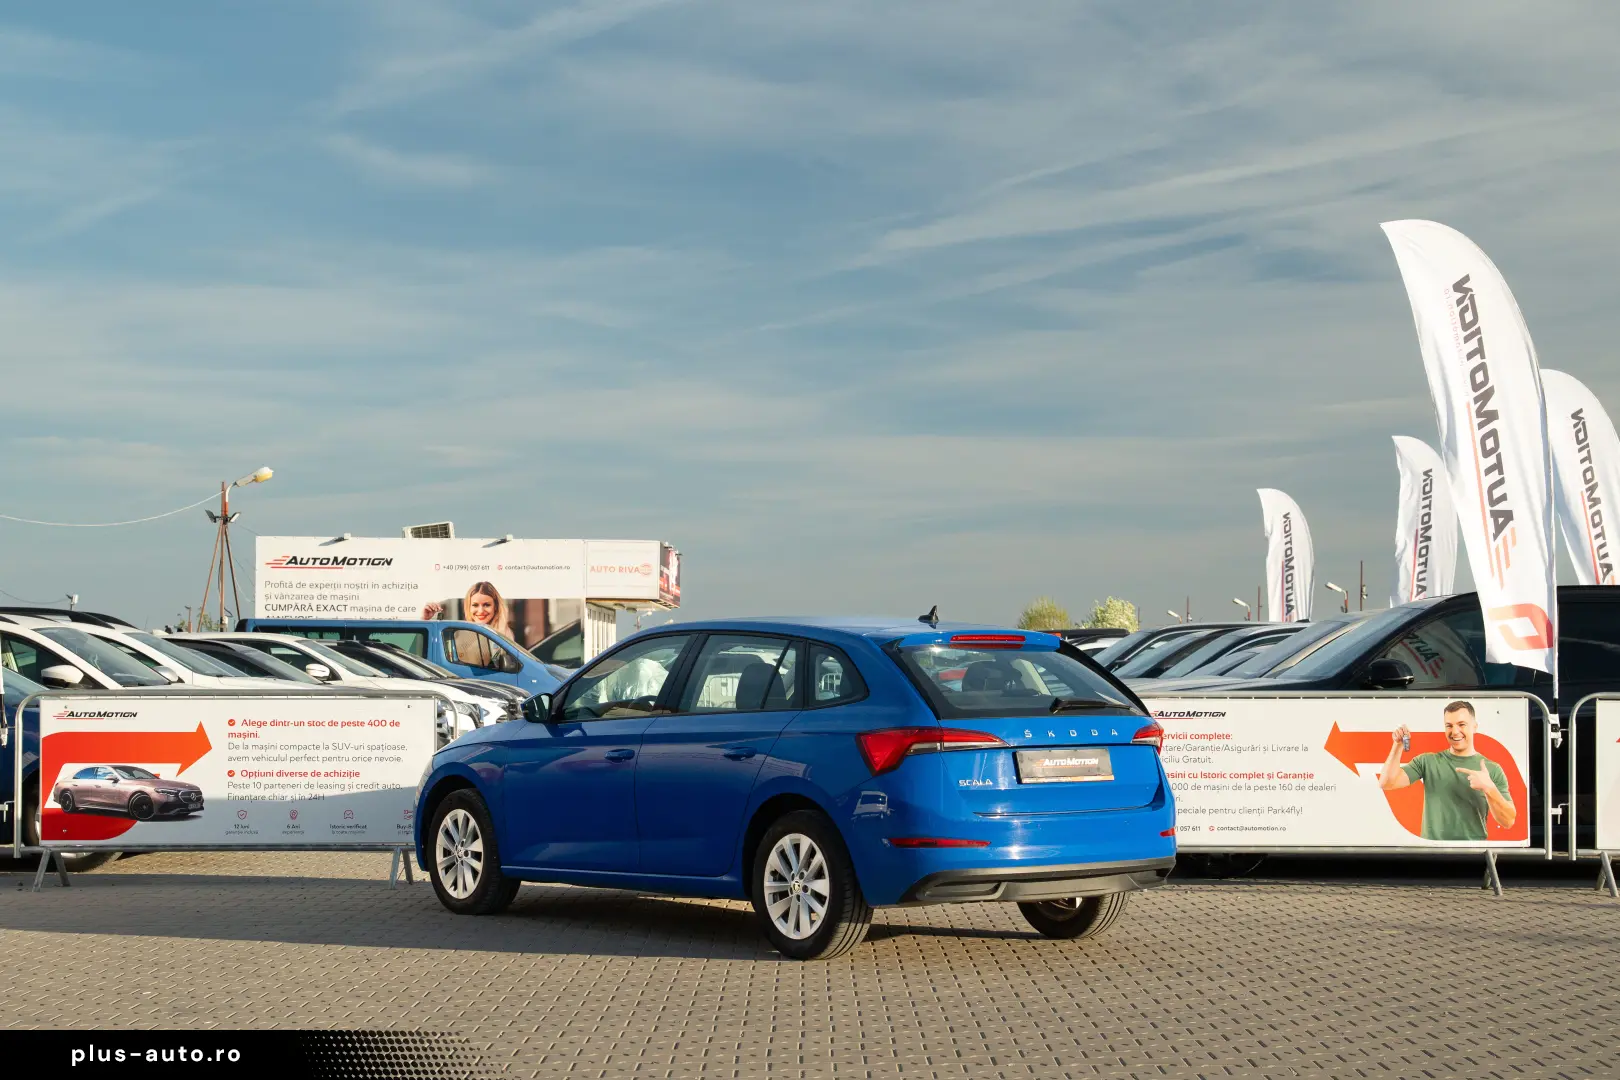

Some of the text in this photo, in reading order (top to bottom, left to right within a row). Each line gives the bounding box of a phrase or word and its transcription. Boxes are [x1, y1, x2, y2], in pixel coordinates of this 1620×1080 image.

[454, 564, 469, 572] (799)
[590, 565, 616, 573] AUTO
[264, 580, 293, 589] Profită
[295, 581, 307, 589] de
[309, 581, 342, 591] experții
[343, 581, 369, 591] noștri
[381, 581, 419, 591] achiziția
[264, 592, 360, 602] și vânzarea de mașini
[264, 602, 417, 614] CUMPĂRĂ EXACT mașina de care
[241, 719, 401, 728] Alege dintr-un stoc de peste 400 de
[227, 731, 260, 740] mașini.
[1163, 732, 1233, 741] ervicii complete:
[227, 742, 240, 750] De
[242, 742, 249, 750] la
[252, 742, 278, 752] mașini
[280, 743, 321, 752] compacte
[322, 742, 330, 750] la
[331, 742, 365, 751] SUV-uri
[1263, 743, 1269, 754] și
[1271, 743, 1300, 752] Livrare
[1301, 743, 1309, 752] la
[252, 753, 288, 762] vehiculul
[289, 753, 320, 764] perfect
[322, 755, 350, 764] pentru
[351, 754, 373, 762] orice
[374, 754, 404, 763] nevoie.
[1182, 755, 1214, 764] Gratuit.
[240, 769, 361, 779] Opțiuni diverse de achiziție
[1200, 770, 1227, 779] Istoric
[1229, 770, 1265, 780] complet
[1267, 771, 1275, 780] și
[1276, 771, 1315, 780] Garanție
[227, 781, 403, 792] Peste 10 parteneri de leasing și credit auto.
[958, 778, 993, 787] SCALA
[1171, 782, 1337, 793] 000 de mașini de la peste 160 de dealeri
[227, 792, 266, 803] Finanțare
[268, 792, 288, 801] chiar
[290, 793, 297, 803] și
[308, 792, 325, 801] 24H
[1208, 806, 1237, 816] pentru
[1238, 805, 1265, 816] clienții
[1267, 805, 1303, 816] Park4fly!
